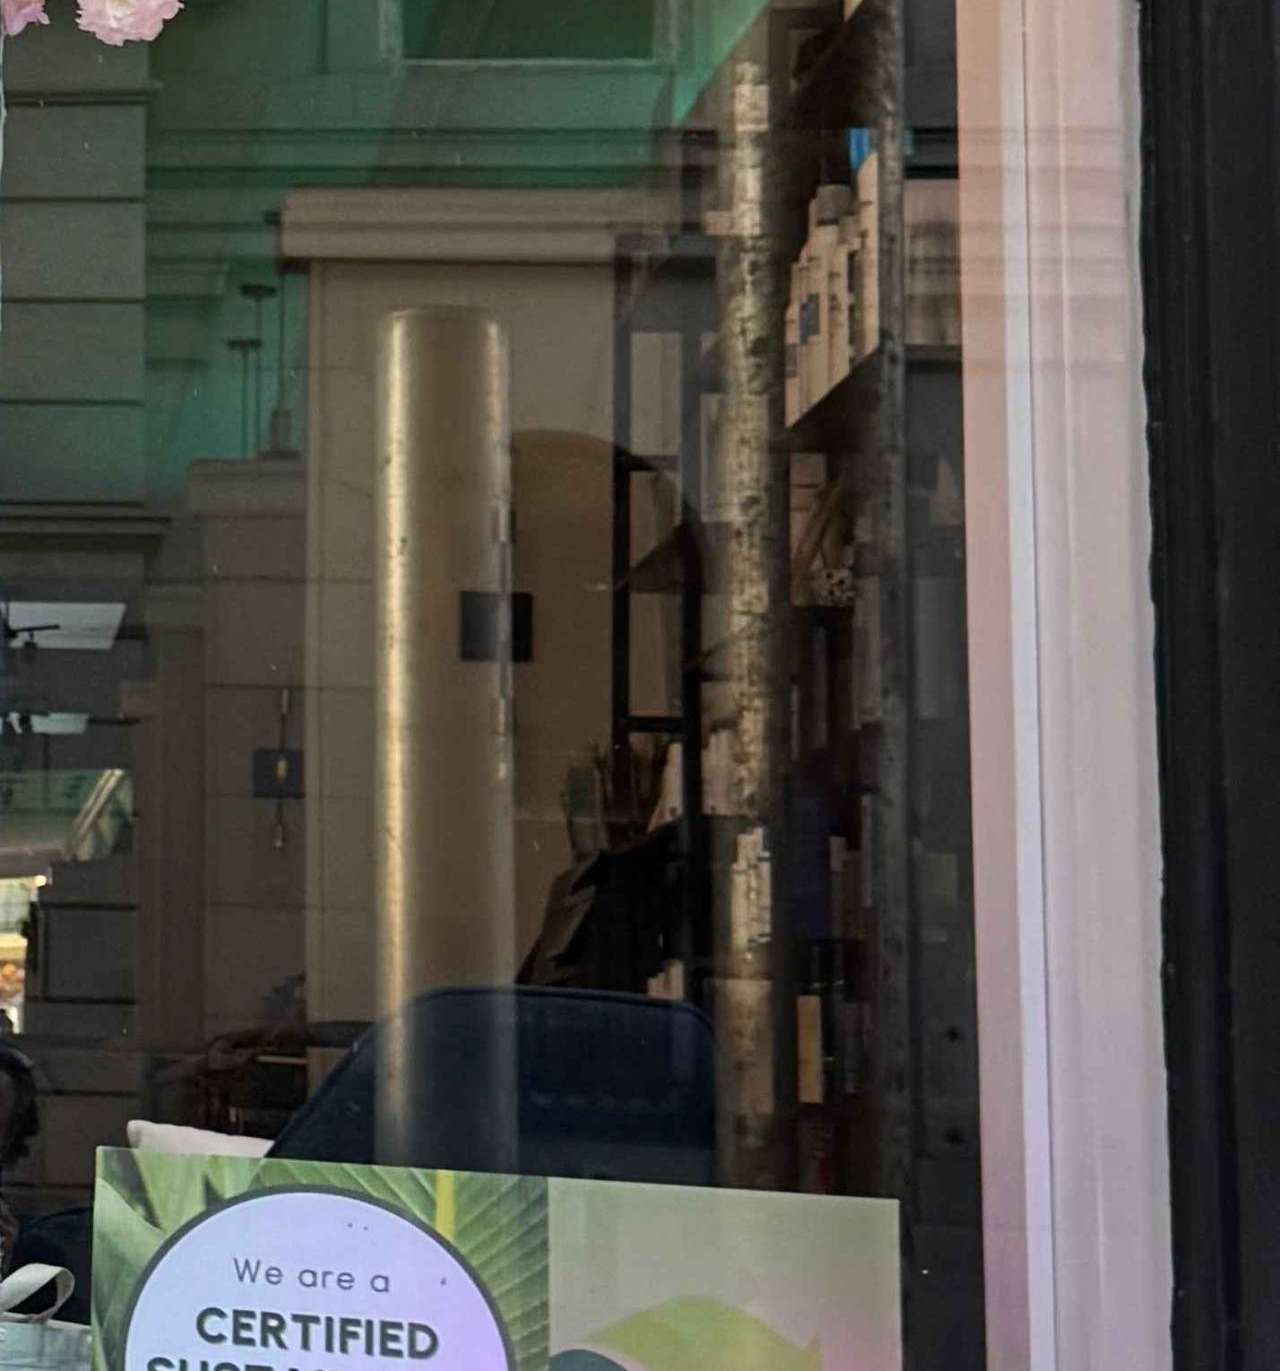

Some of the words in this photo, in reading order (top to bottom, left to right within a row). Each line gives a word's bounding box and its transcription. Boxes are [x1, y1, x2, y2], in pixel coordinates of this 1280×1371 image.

[233, 1257, 284, 1286] We
[298, 1267, 356, 1292] are
[370, 1272, 390, 1294] a
[195, 1306, 439, 1361] CERTIFIED
